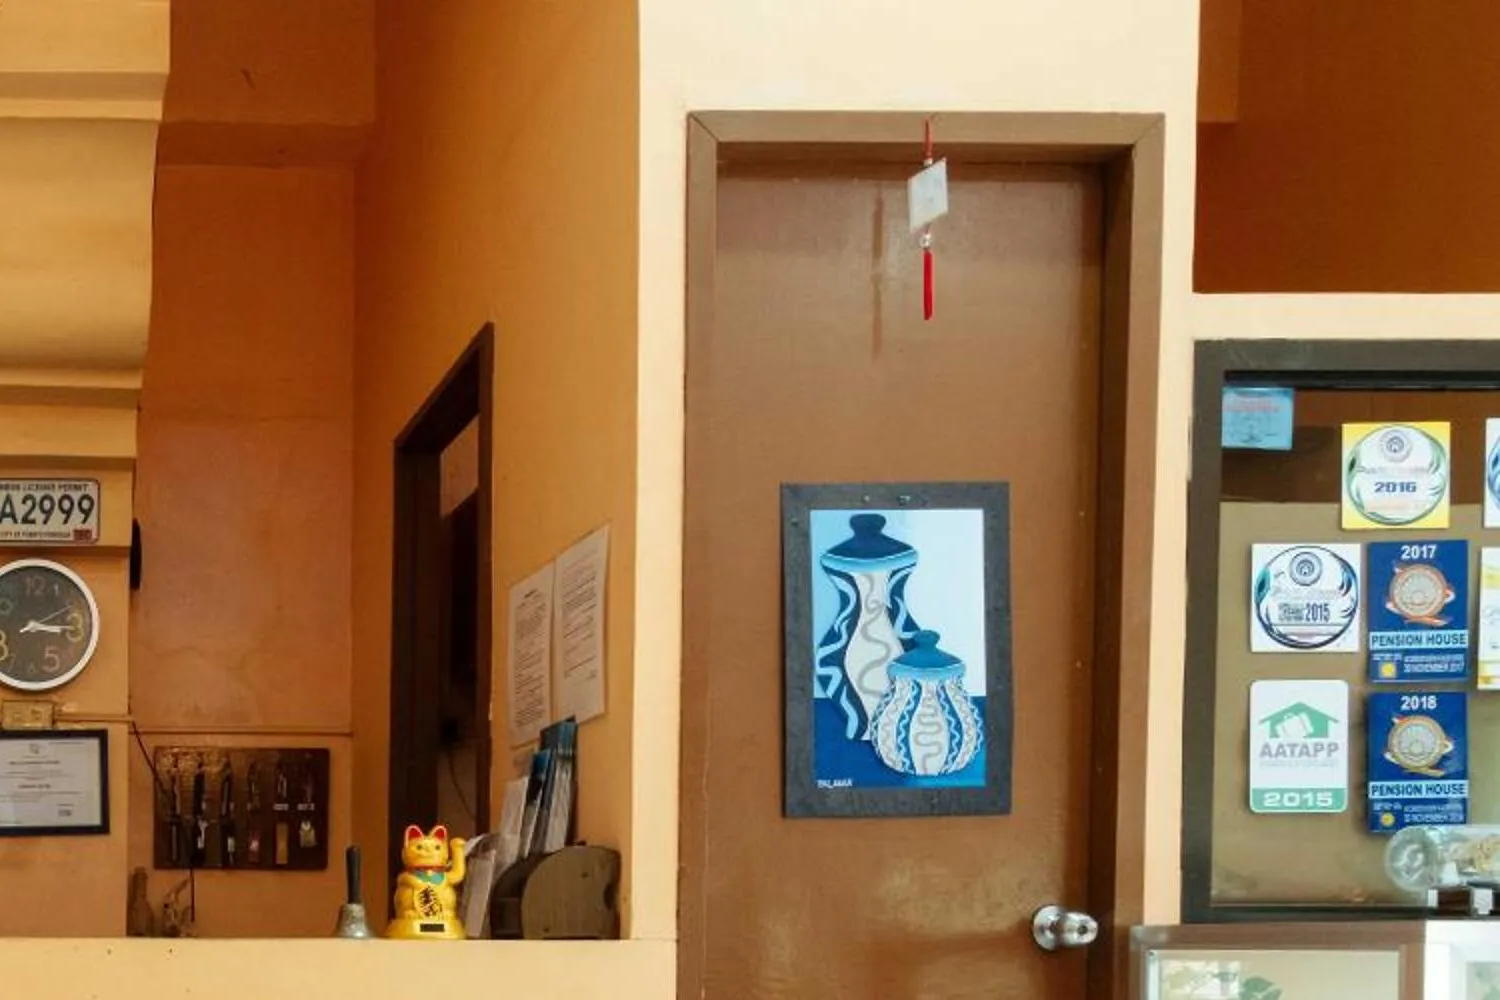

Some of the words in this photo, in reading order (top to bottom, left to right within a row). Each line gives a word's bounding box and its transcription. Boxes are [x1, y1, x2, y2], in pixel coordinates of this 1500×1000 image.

[1374, 481, 1417, 494] 2016
[1401, 544, 1437, 560] 2017
[1305, 602, 1331, 622] 2015
[1371, 634, 1423, 646] PENSION
[1428, 633, 1467, 646] HOUSE
[42, 645, 61, 672] 5
[1401, 695, 1438, 710] 2018
[1260, 742, 1340, 759] AATAPP
[1371, 785, 1422, 796] PENSION
[1426, 784, 1466, 795] HOUSE
[1263, 792, 1333, 807] 2015
